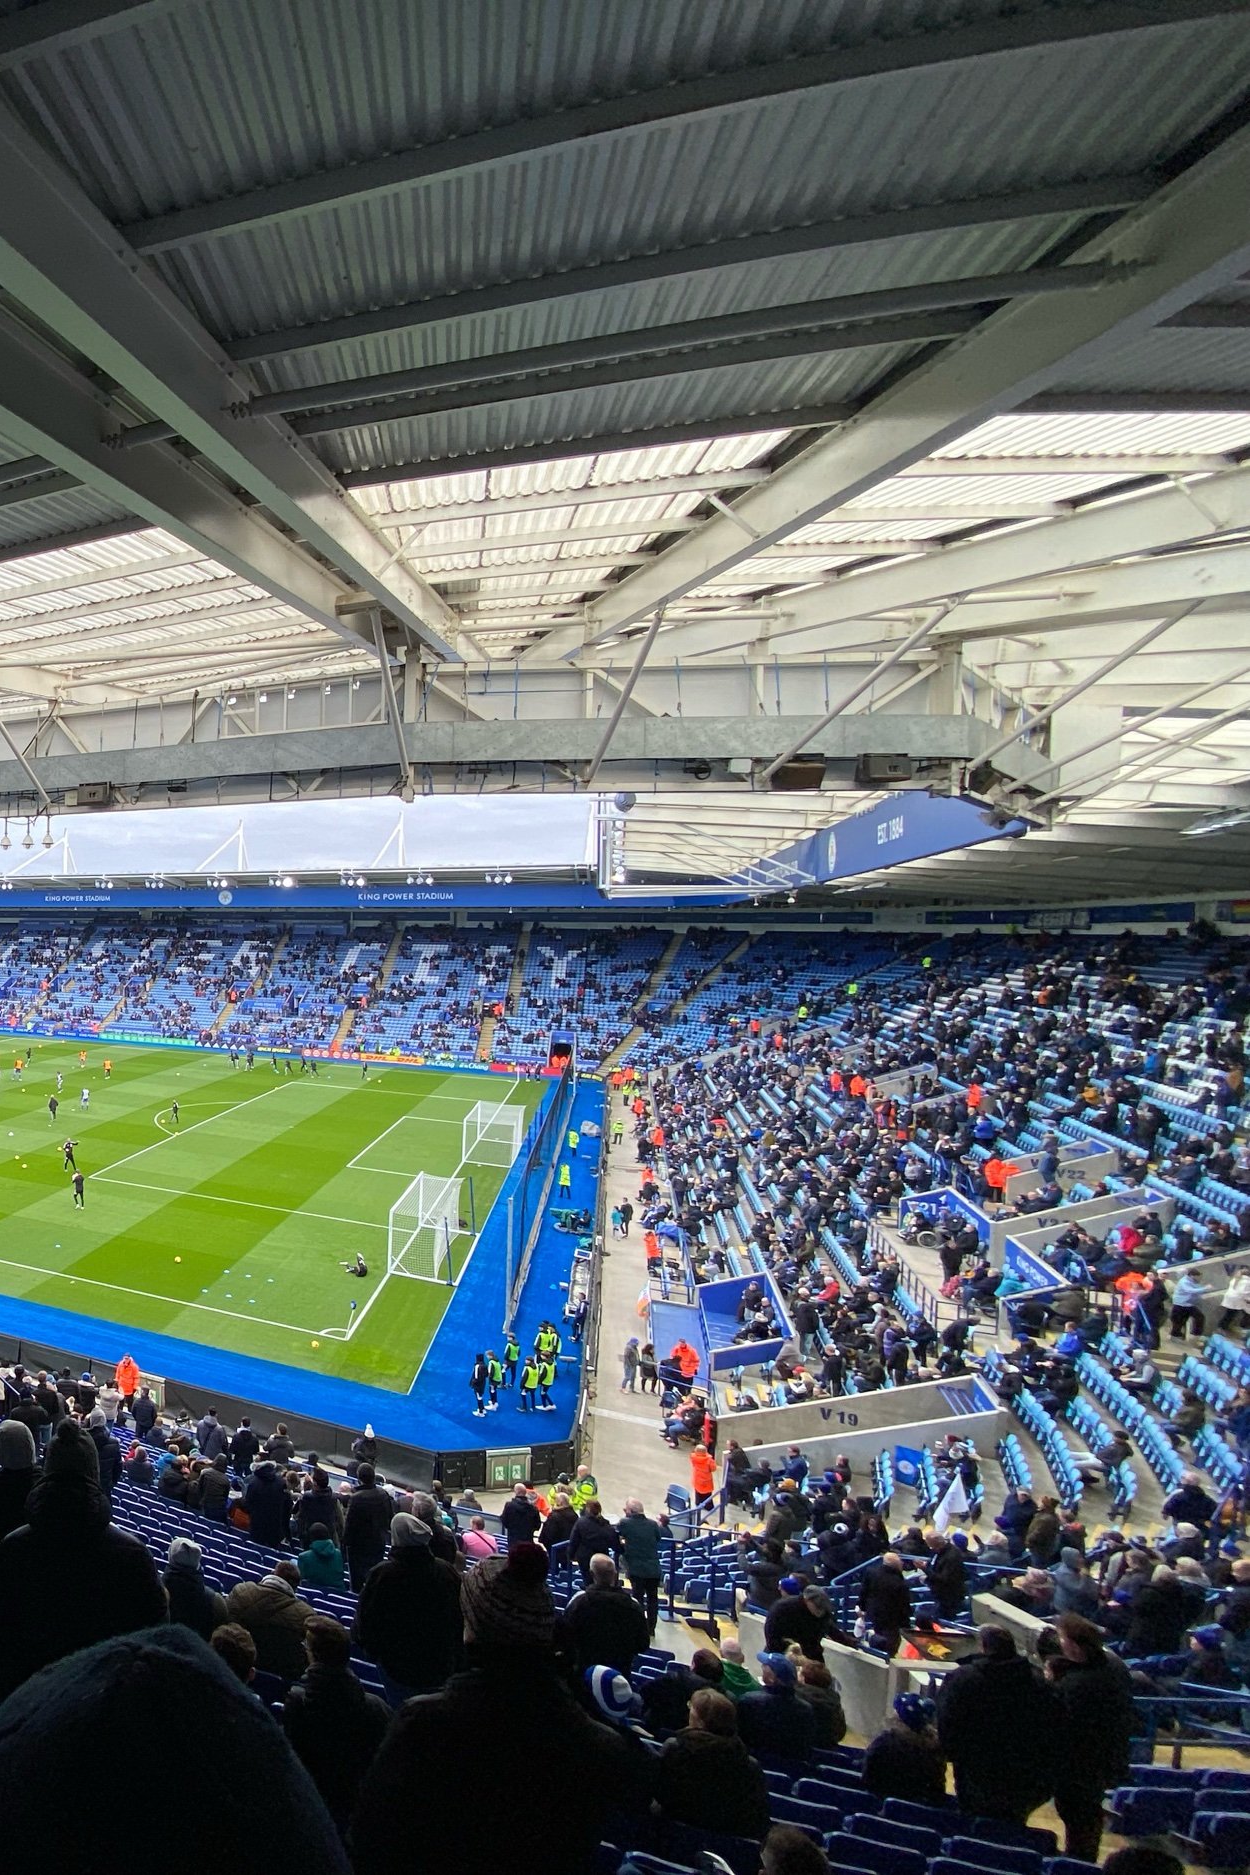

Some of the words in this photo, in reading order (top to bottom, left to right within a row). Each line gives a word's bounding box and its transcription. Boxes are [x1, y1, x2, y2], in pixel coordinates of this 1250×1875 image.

[877, 822, 889, 845] EST.
[889, 815, 904, 841] 1884
[358, 893, 380, 901] KING
[416, 892, 454, 900] STADIUM
[468, 1062, 489, 1071] Chang
